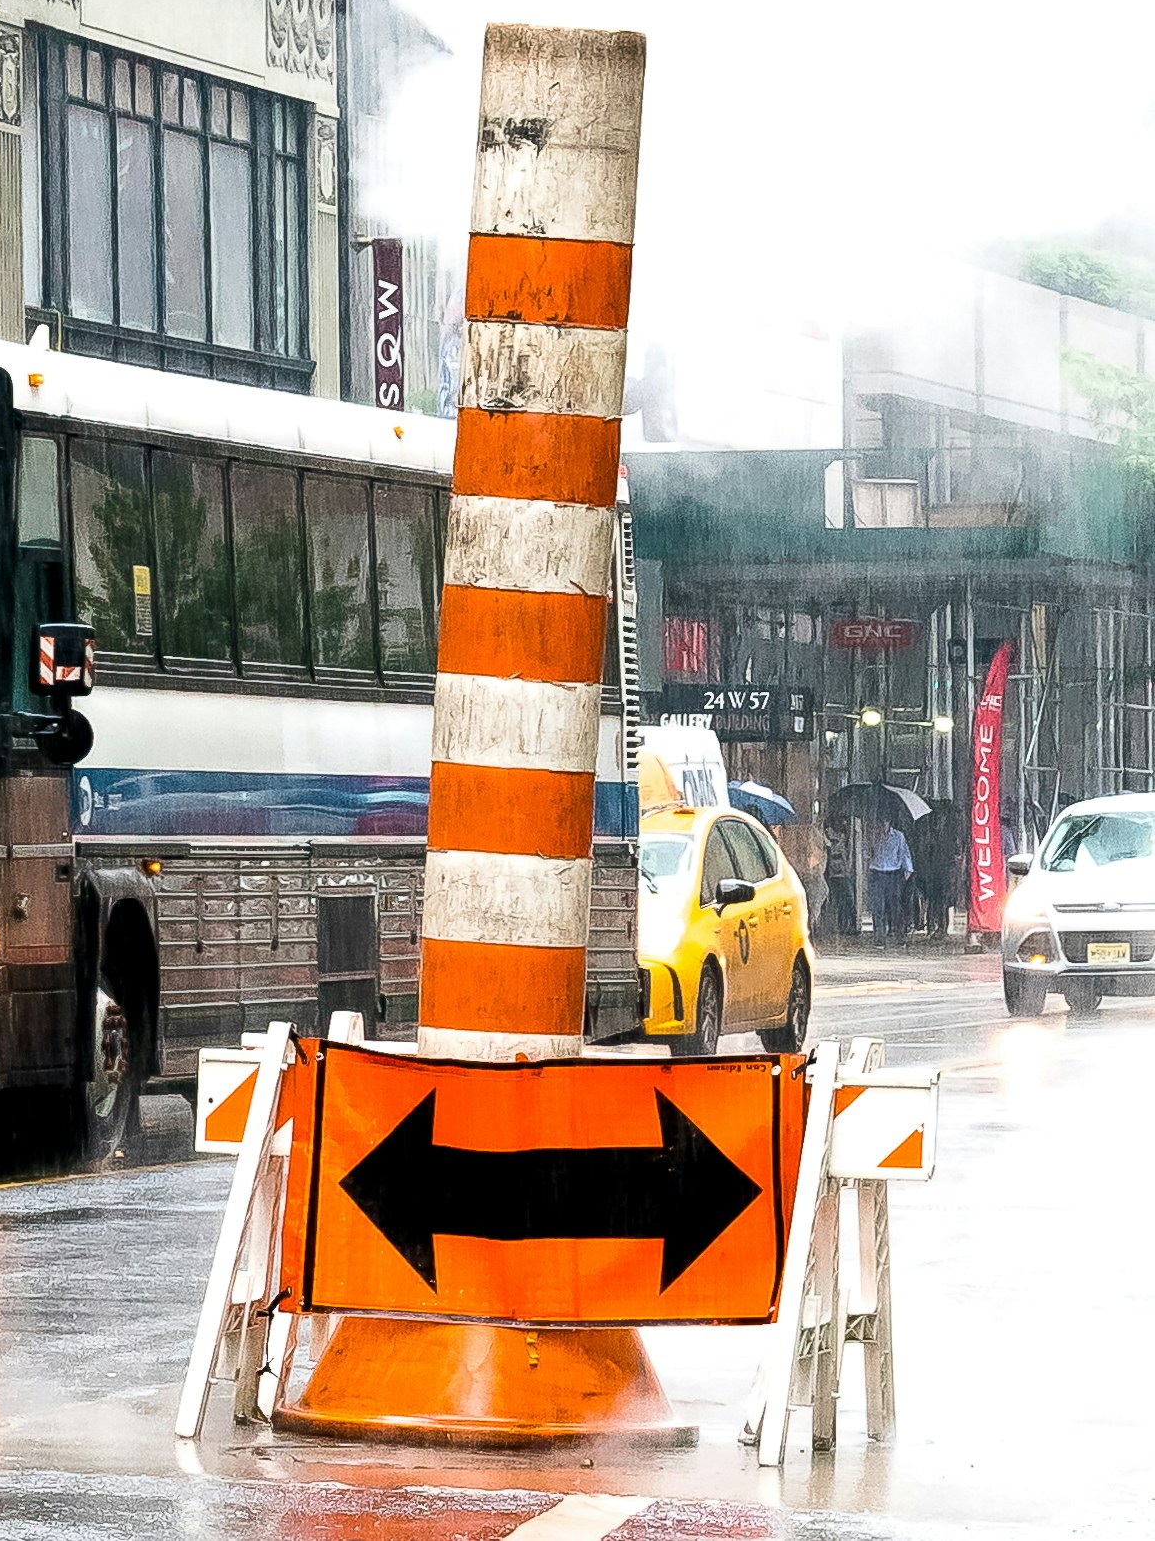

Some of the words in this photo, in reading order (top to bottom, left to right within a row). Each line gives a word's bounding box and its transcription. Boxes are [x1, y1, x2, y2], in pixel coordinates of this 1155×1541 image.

[844, 624, 902, 638] GNC
[703, 691, 725, 710] 24
[727, 691, 747, 710] W
[748, 691, 770, 710] 57
[659, 712, 713, 730] GALLERY
[975, 723, 996, 902] WELCOME
